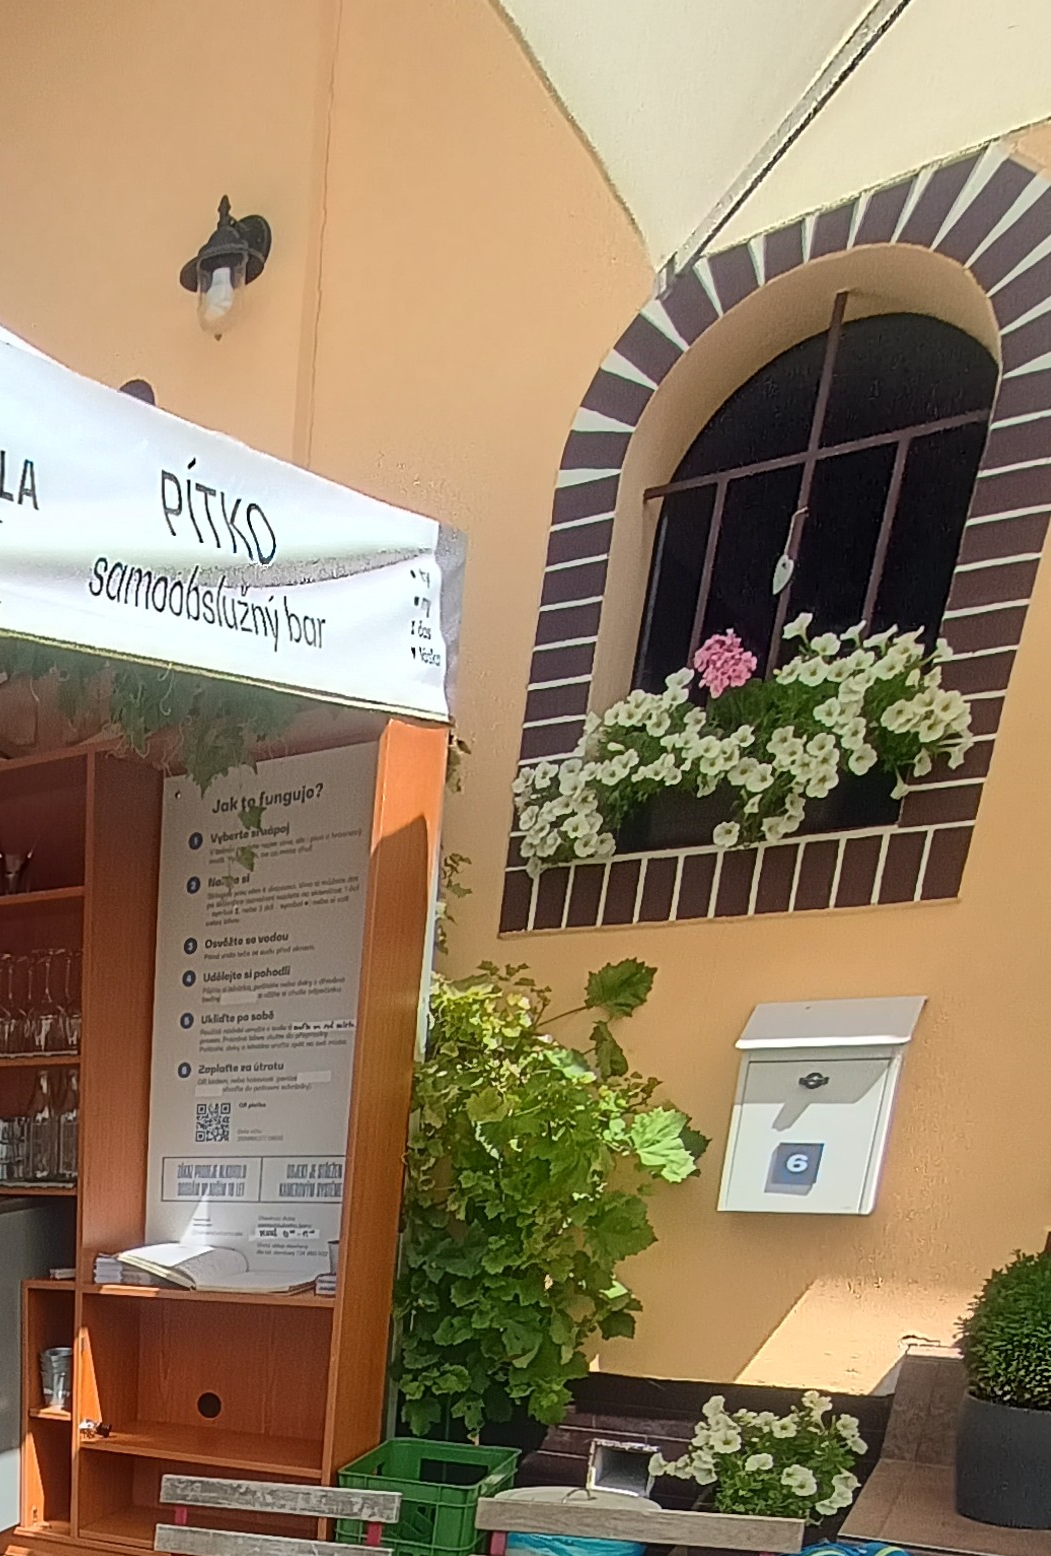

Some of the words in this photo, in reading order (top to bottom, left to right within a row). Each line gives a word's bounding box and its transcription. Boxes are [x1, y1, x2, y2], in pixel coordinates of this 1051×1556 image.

[160, 457, 277, 566] PÍTKO
[88, 556, 279, 653] samoobslužný
[284, 595, 326, 649] bar
[211, 796, 238, 814] Jak
[240, 795, 256, 810] to
[259, 783, 324, 807] funguje?
[258, 932, 289, 944] vodou
[236, 1014, 249, 1024] po
[251, 1010, 275, 1021] sobě
[253, 1061, 285, 1073] útratu
[786, 1153, 809, 1173] 6
